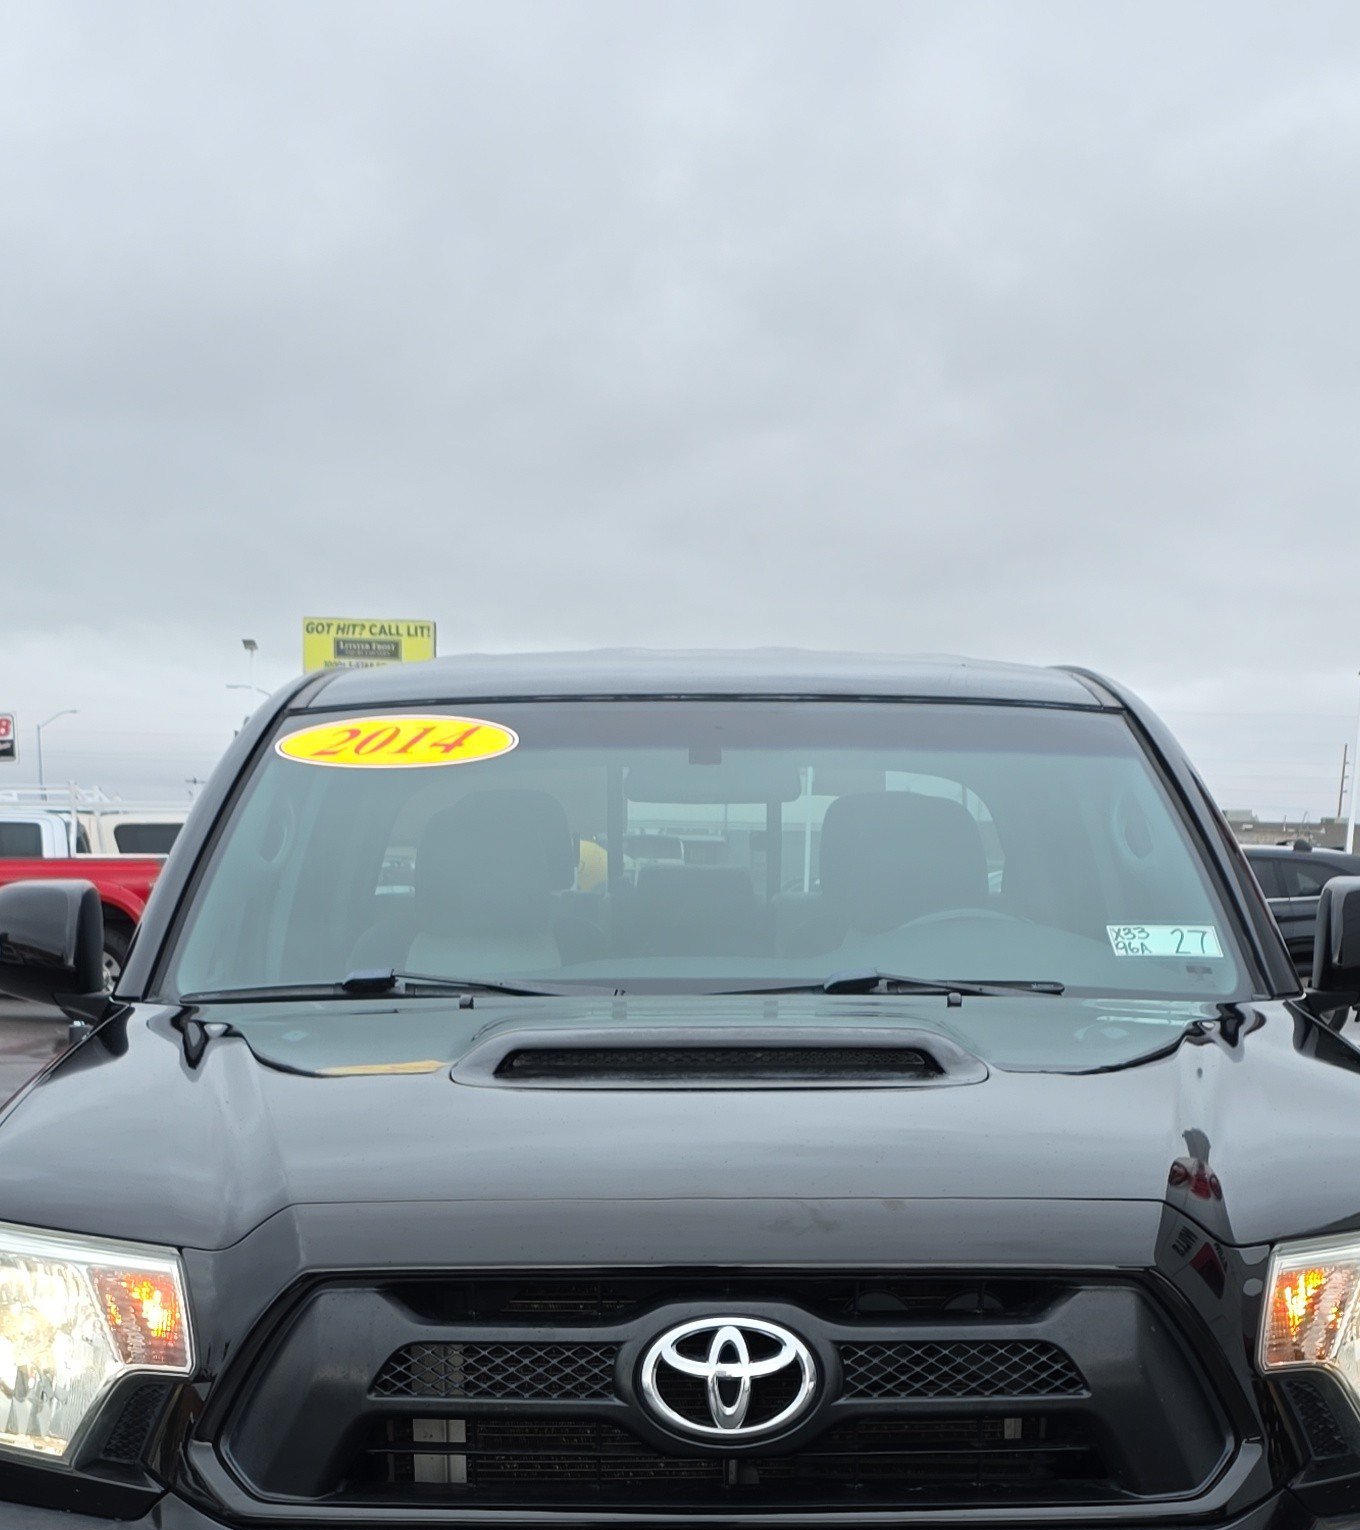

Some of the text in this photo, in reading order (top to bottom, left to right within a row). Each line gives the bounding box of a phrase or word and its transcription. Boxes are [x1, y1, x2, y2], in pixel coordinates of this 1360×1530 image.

[306, 622, 431, 637] GOT HIT? CALL LIT!
[310, 725, 482, 756] 2014
[1112, 926, 1208, 954] X33 27
[1115, 940, 1152, 955] 96A
